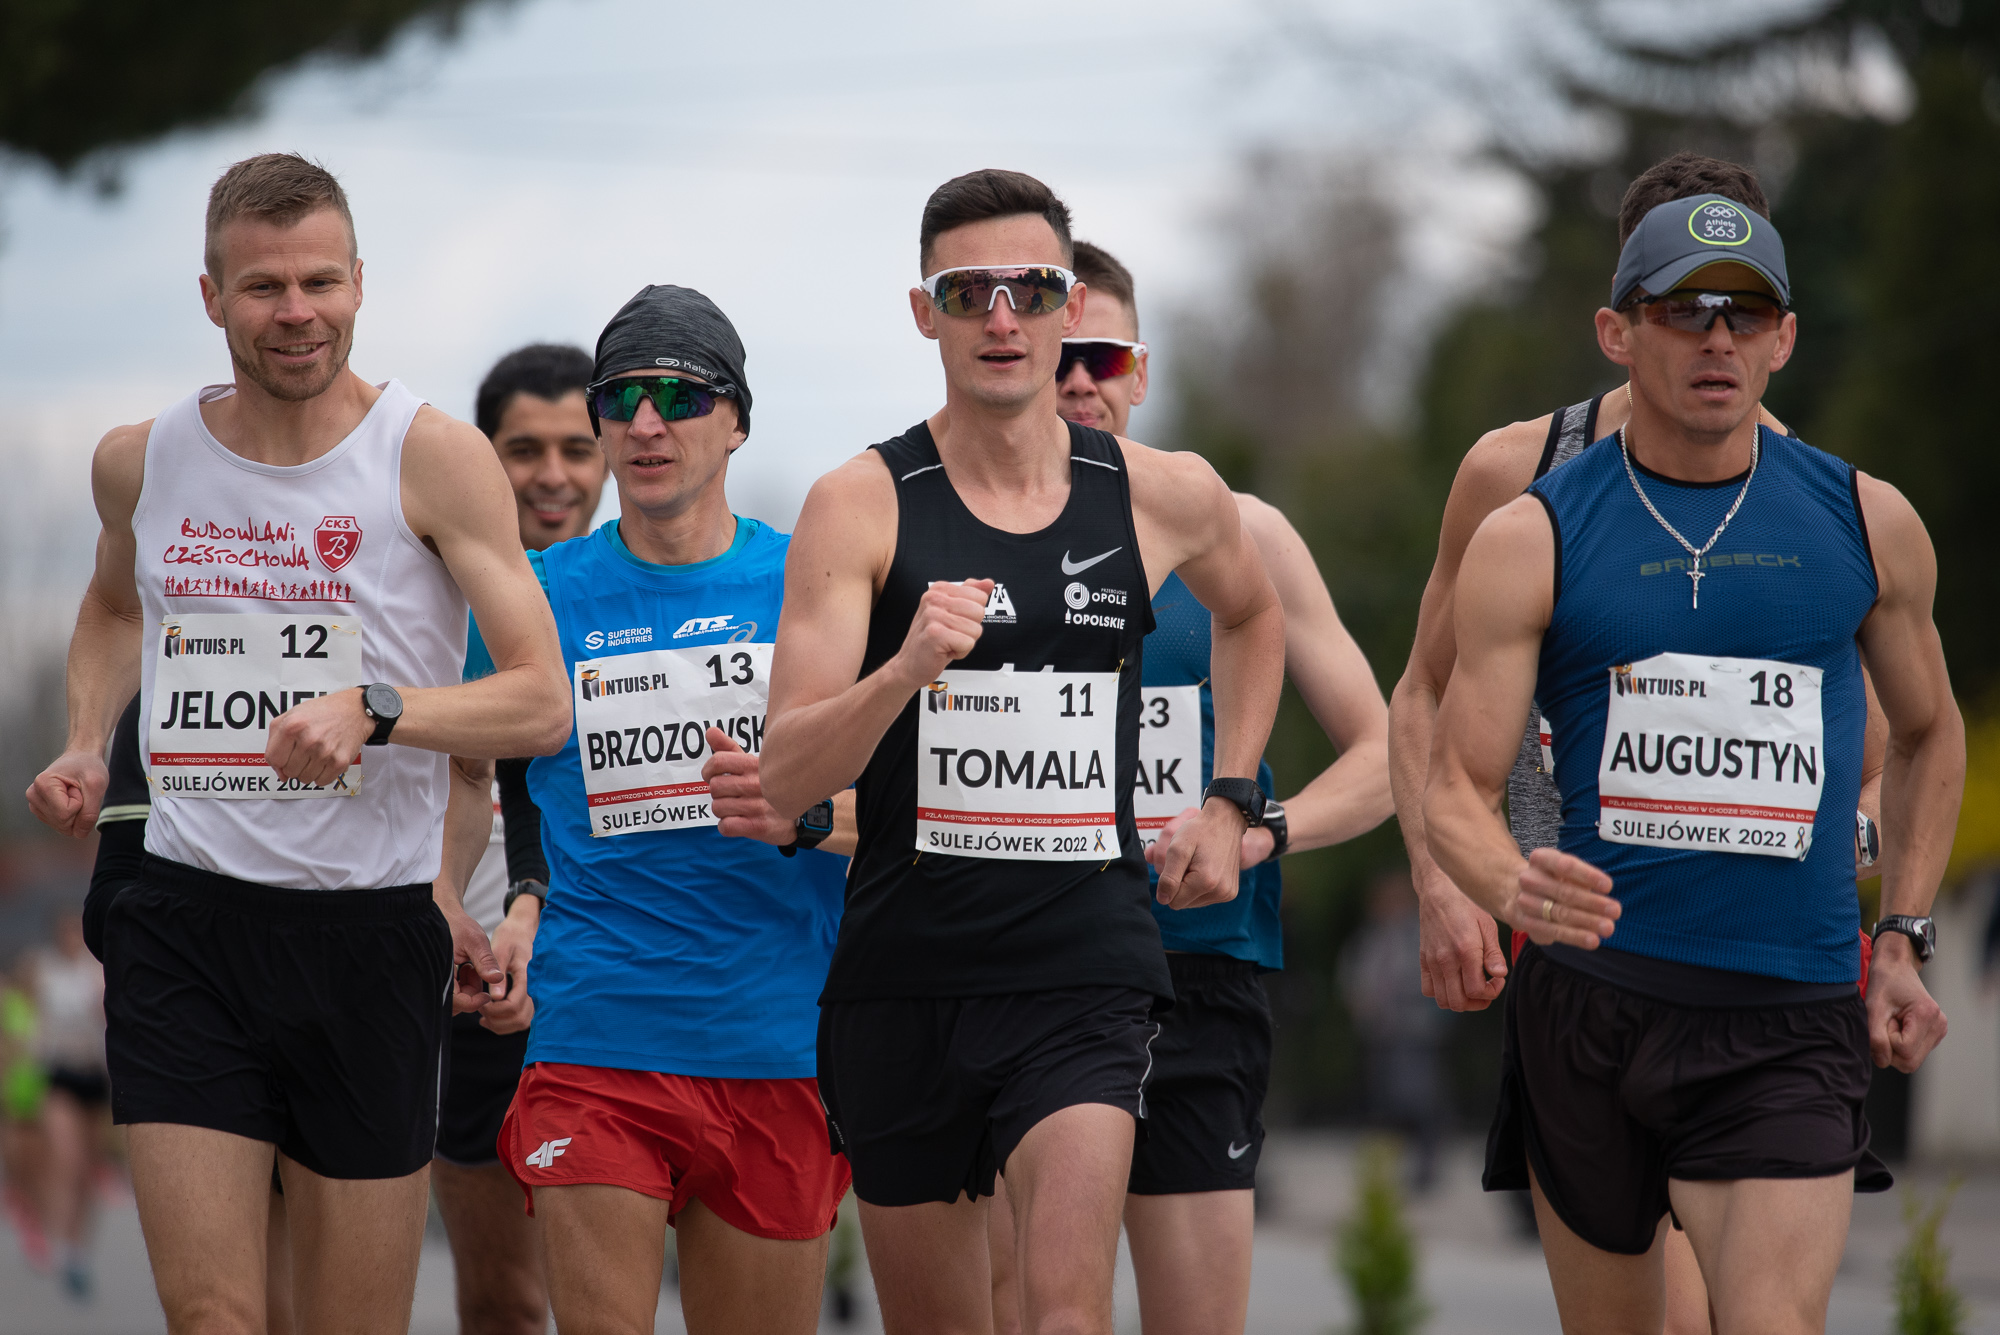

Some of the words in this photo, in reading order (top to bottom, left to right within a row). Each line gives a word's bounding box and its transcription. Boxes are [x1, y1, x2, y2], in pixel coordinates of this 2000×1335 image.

[1704, 226, 1736, 238] 365
[1705, 219, 1736, 229] Athlete
[325, 520, 350, 529] CKS
[323, 533, 348, 559] B
[1640, 553, 1801, 576] BRUBECK
[1092, 592, 1127, 605] OPOLE
[673, 615, 735, 634] ATS
[1073, 613, 1125, 629] OPOLSKIE
[280, 624, 328, 659] 12
[608, 628, 652, 639] SUPERIOR
[608, 635, 653, 646] INDUSTRIES
[705, 652, 754, 688] 13
[1749, 671, 1794, 708] 18
[1058, 683, 1094, 718] 11
[930, 747, 1106, 790] TOMALA
[1609, 732, 1817, 786] AUGUSTYN
[162, 772, 270, 791] SULEJÓWEK
[611, 791, 653, 801] MISTRZOSTWA
[602, 804, 710, 830] SULEJÓWEK
[943, 813, 990, 823] MISTRZOSTWA
[1627, 801, 1673, 811] MISTRZOSTWA
[1674, 805, 1699, 813] POLSKI
[1708, 807, 1738, 815] CHODZIE
[1739, 809, 1785, 818] SPORTOWYM
[930, 831, 1046, 852] SULEJÓWEK
[1052, 837, 1087, 853] 2022
[1612, 820, 1731, 844] SULEJÓWEK
[1738, 829, 1787, 847] 2022
[525, 1137, 572, 1168] 4F
